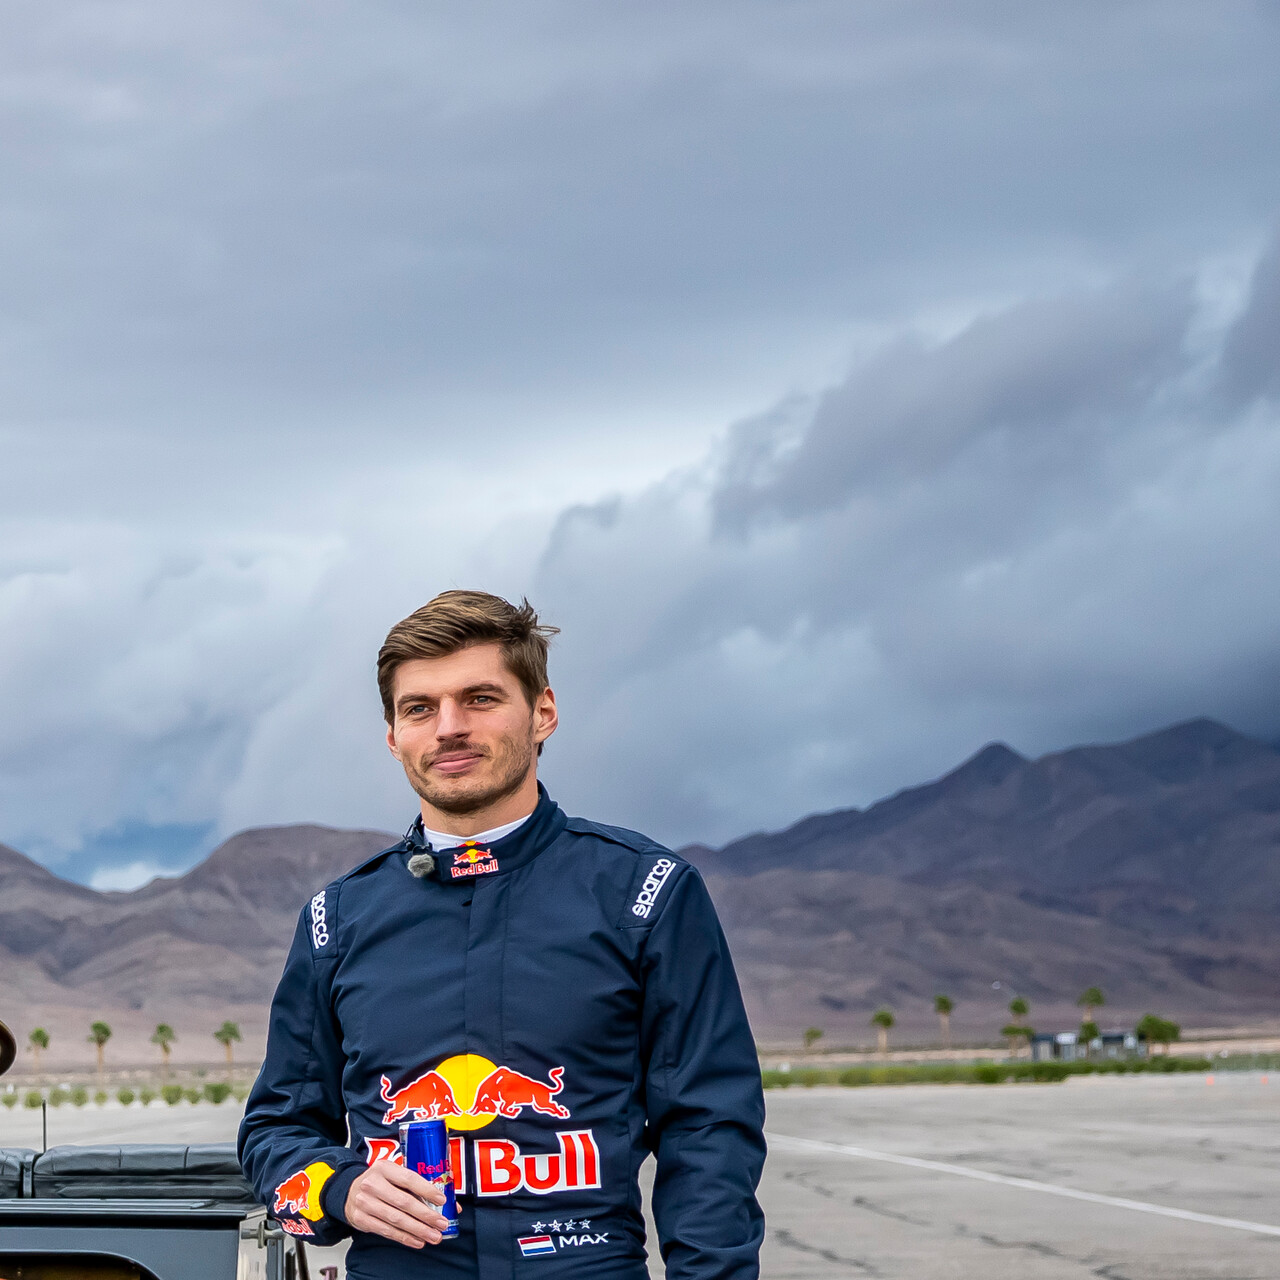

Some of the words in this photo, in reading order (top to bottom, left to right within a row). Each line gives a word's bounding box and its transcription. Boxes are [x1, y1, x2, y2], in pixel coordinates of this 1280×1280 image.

[451, 864, 475, 878] Red
[475, 859, 499, 874] Bull
[632, 858, 676, 918] sparco
[311, 890, 329, 949] sparco
[417, 1160, 444, 1175] Red
[475, 1130, 601, 1197] Bull
[559, 1232, 609, 1248] MAX
